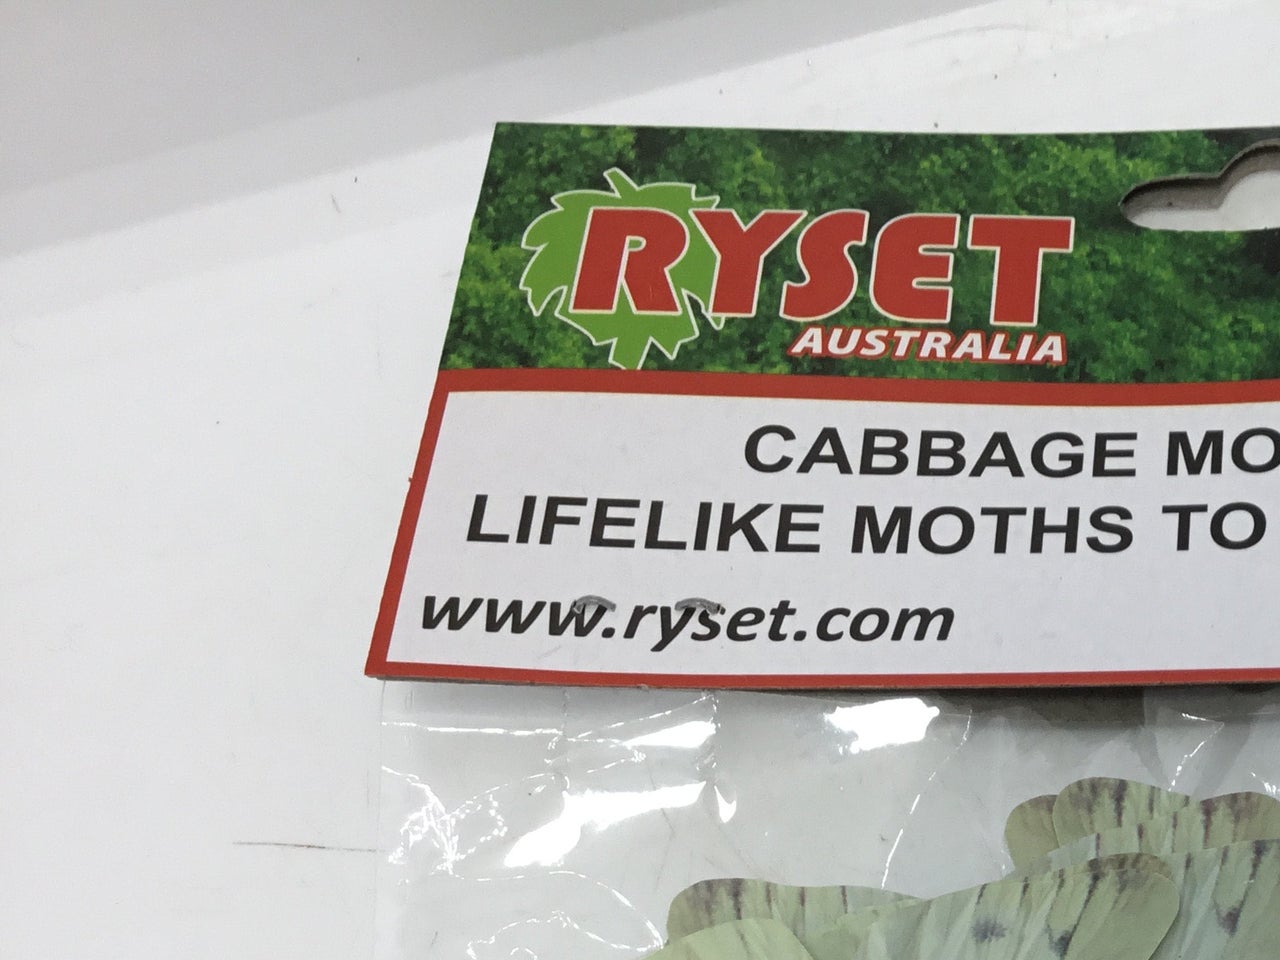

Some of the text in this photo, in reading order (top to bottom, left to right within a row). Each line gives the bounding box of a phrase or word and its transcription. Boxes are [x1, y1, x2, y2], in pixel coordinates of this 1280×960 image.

[568, 206, 1076, 327] RYSET
[789, 327, 1067, 364] AUSTRALIA
[744, 425, 1137, 478] CABBAGE
[465, 494, 821, 553] LIFELIKE
[850, 503, 1134, 555] MOTHS
[1163, 501, 1266, 551] TO
[421, 594, 955, 652] www.ryset.com
